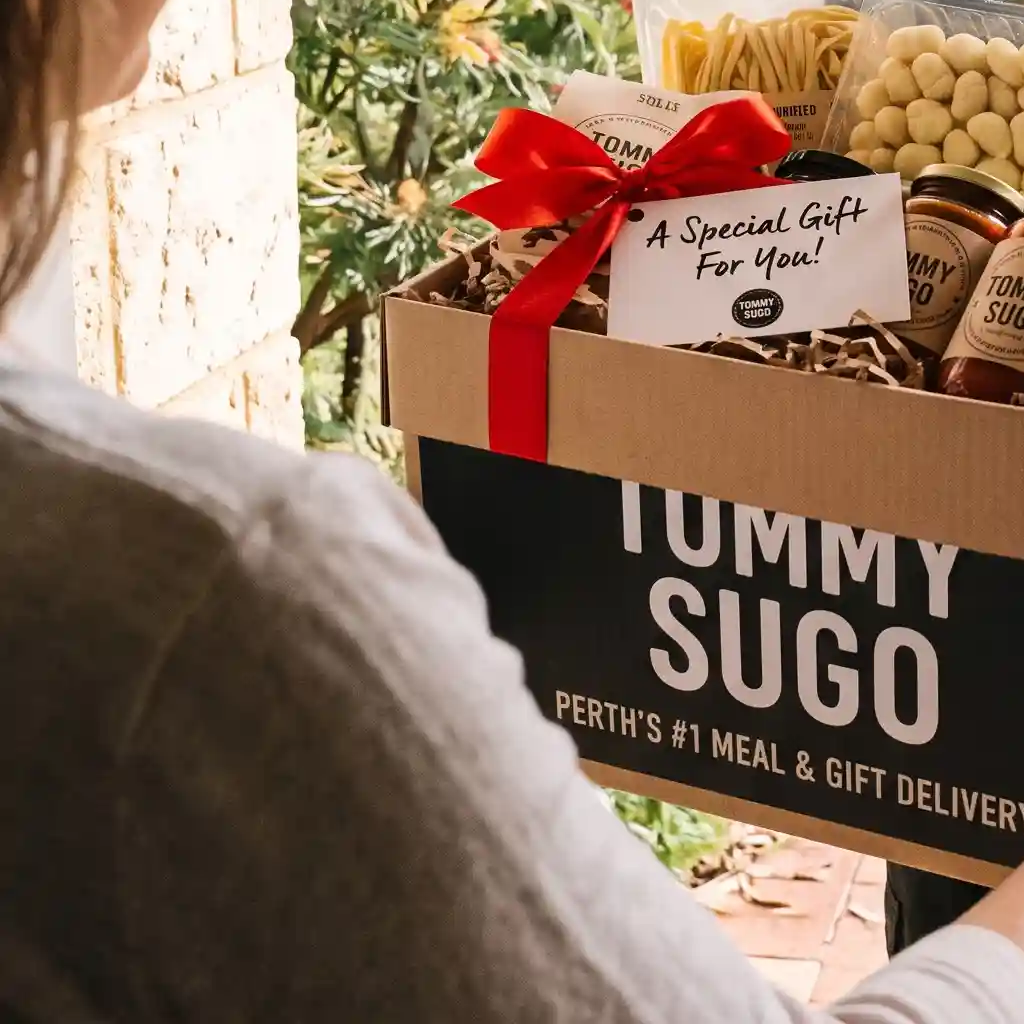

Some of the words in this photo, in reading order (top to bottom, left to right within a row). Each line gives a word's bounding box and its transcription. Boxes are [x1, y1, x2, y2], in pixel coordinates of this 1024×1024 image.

[646, 219, 671, 249] A
[680, 206, 791, 250] Special
[799, 195, 869, 236] Gift
[696, 250, 745, 280] For
[754, 236, 824, 280] You!
[739, 297, 775, 311] TOMMY
[621, 479, 960, 619] TOMMY
[649, 576, 939, 745] SUGO
[555, 690, 662, 744] PERTH'S
[671, 719, 700, 754] #1
[711, 728, 786, 775] MEAL
[795, 750, 816, 782] &
[826, 757, 887, 799] GIFT
